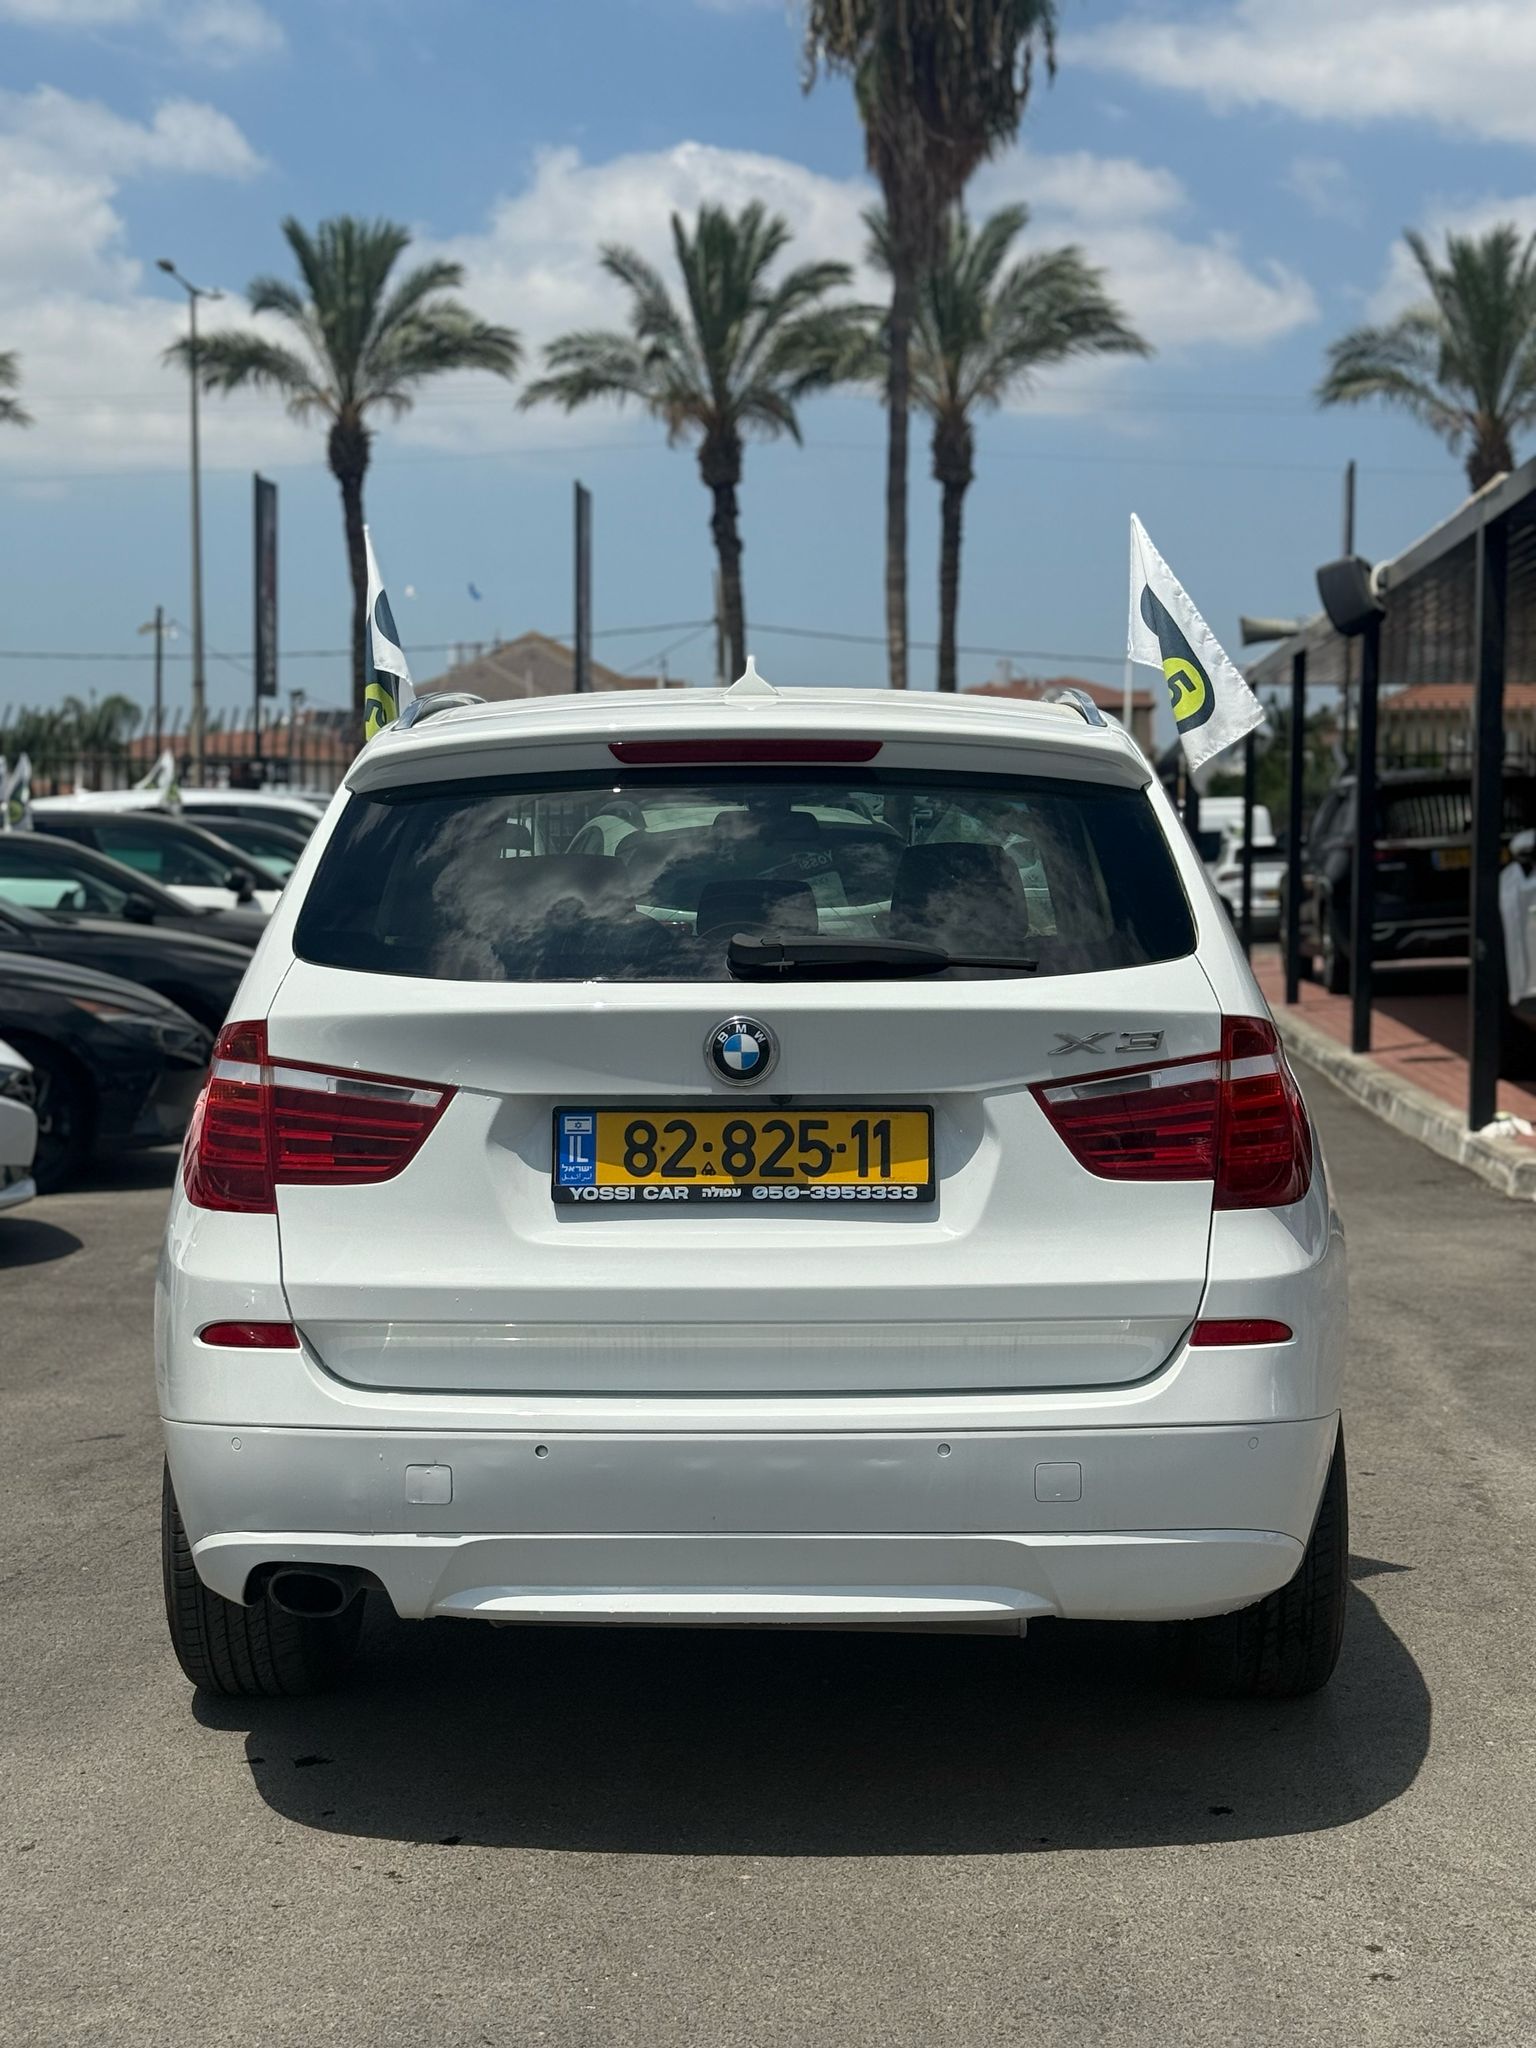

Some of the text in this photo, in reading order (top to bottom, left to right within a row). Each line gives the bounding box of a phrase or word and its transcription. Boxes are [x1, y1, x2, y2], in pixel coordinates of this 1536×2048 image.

[717, 1024, 766, 1044] BMW
[1047, 1030, 1165, 1056] X3
[569, 1135, 589, 1163] IL
[561, 1163, 592, 1172] ישראל
[569, 1186, 918, 1200] YOSSI CAR עפולה 050-3953333
